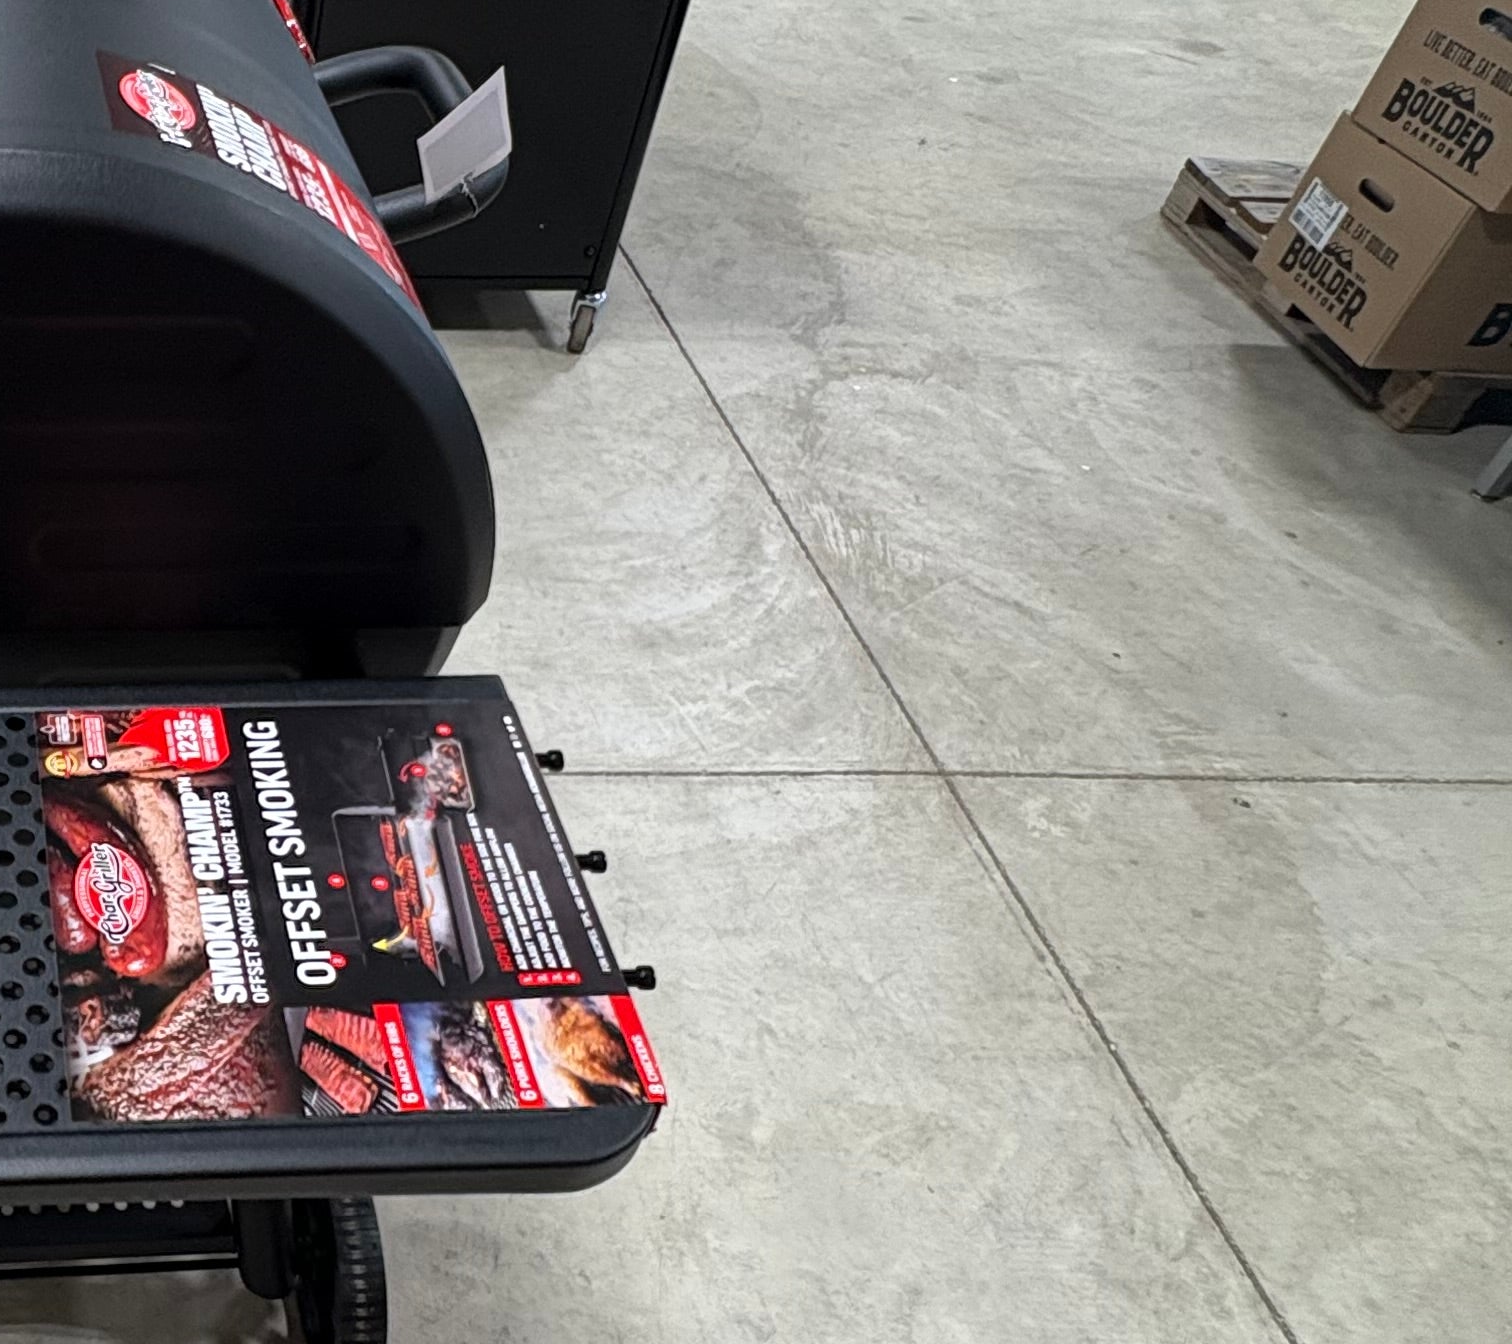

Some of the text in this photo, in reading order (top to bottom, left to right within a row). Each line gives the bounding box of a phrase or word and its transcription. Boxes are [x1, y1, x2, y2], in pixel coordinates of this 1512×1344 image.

[1423, 27, 1447, 54] LIVE
[1472, 57, 1496, 81] EAT
[1381, 77, 1495, 175] BOULDER
[1401, 120, 1455, 160] CANYON
[1277, 233, 1368, 330] BOULDER
[1293, 272, 1337, 315] CANYON
[173, 719, 201, 761] 1235
[242, 719, 337, 987] OFFSET SMOKING
[213, 790, 271, 1004] OFFSET SMOKER MODEL #1733
[401, 1092, 419, 1104] 6
[519, 1089, 537, 1101] 6
[647, 1083, 666, 1095] 8
